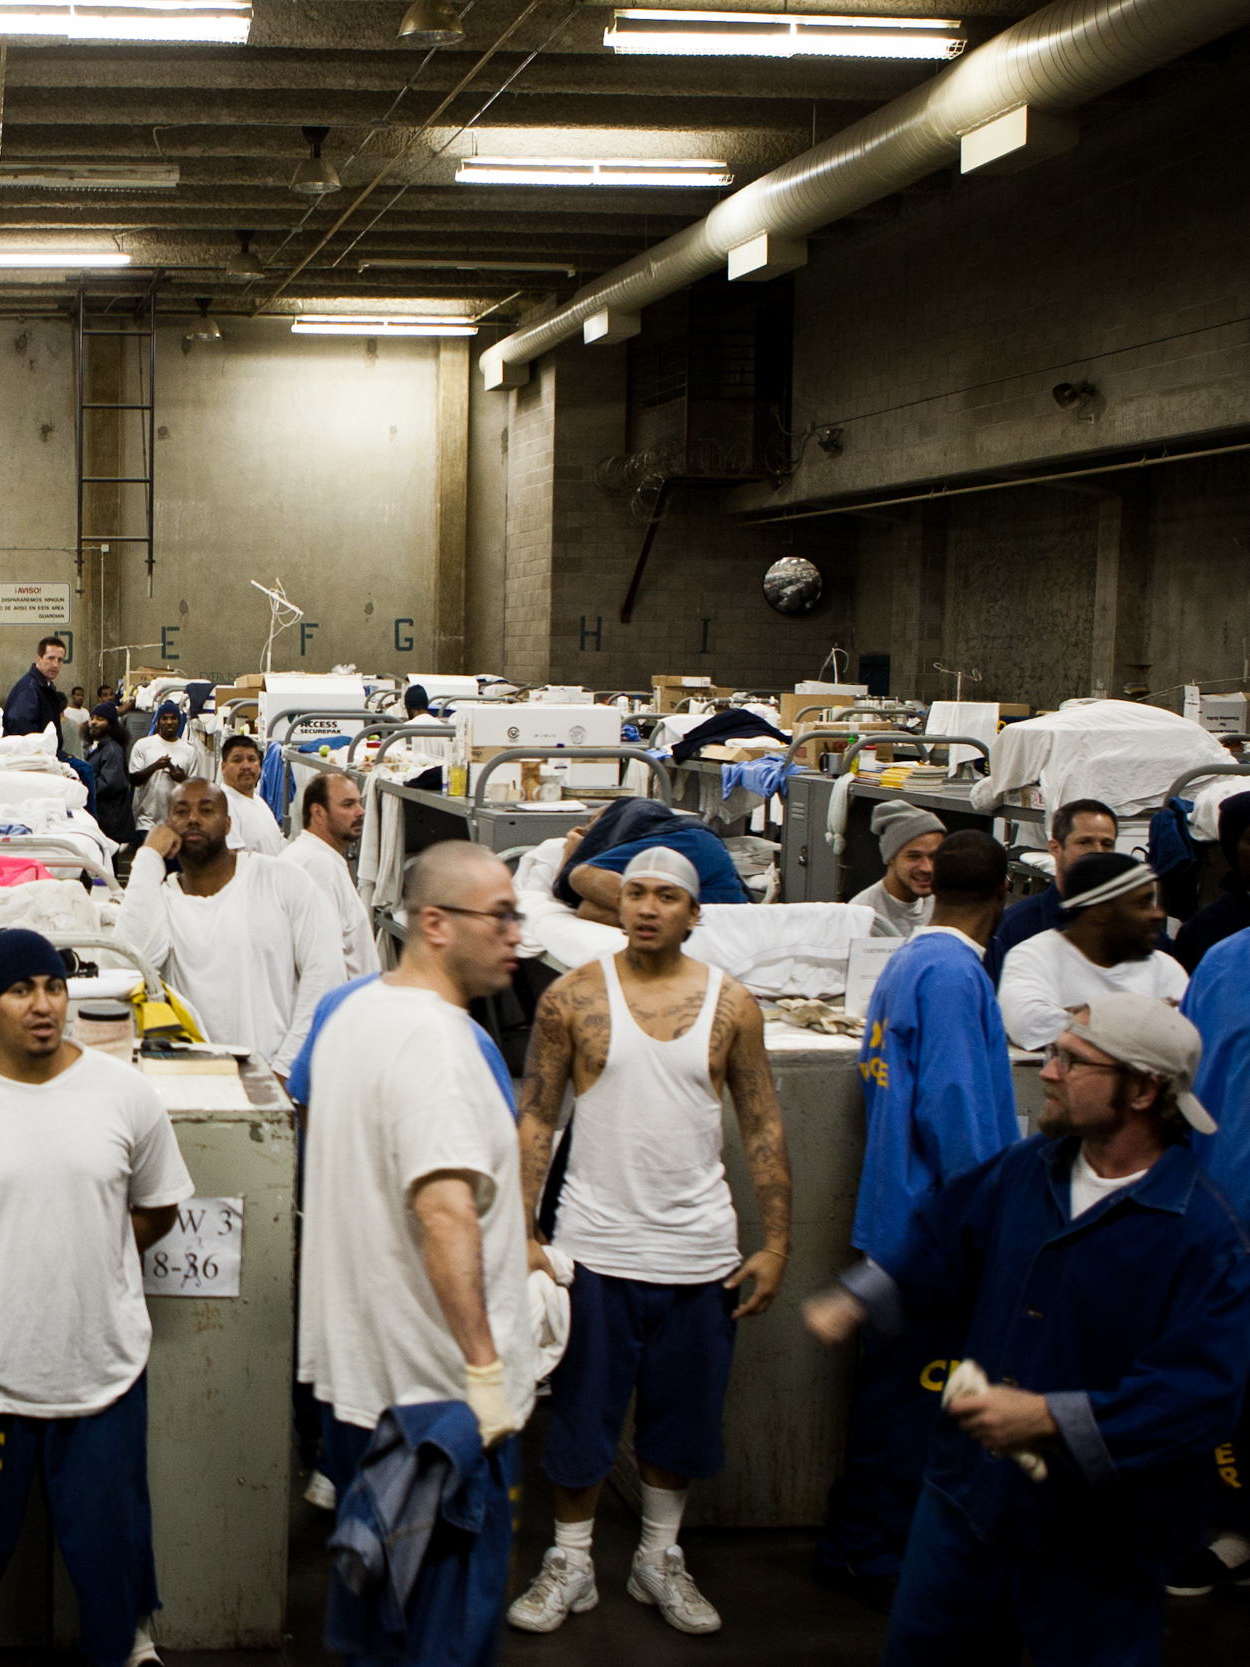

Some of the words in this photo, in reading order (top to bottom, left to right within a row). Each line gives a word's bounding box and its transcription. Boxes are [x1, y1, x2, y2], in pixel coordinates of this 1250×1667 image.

[14, 587, 42, 595] ¡AVISO!
[161, 626, 180, 660] E
[300, 623, 319, 656] F
[394, 618, 414, 652] G
[579, 615, 603, 652] H
[699, 617, 713, 654] I
[300, 720, 338, 728] ACCESS
[217, 1209, 233, 1236] 3
